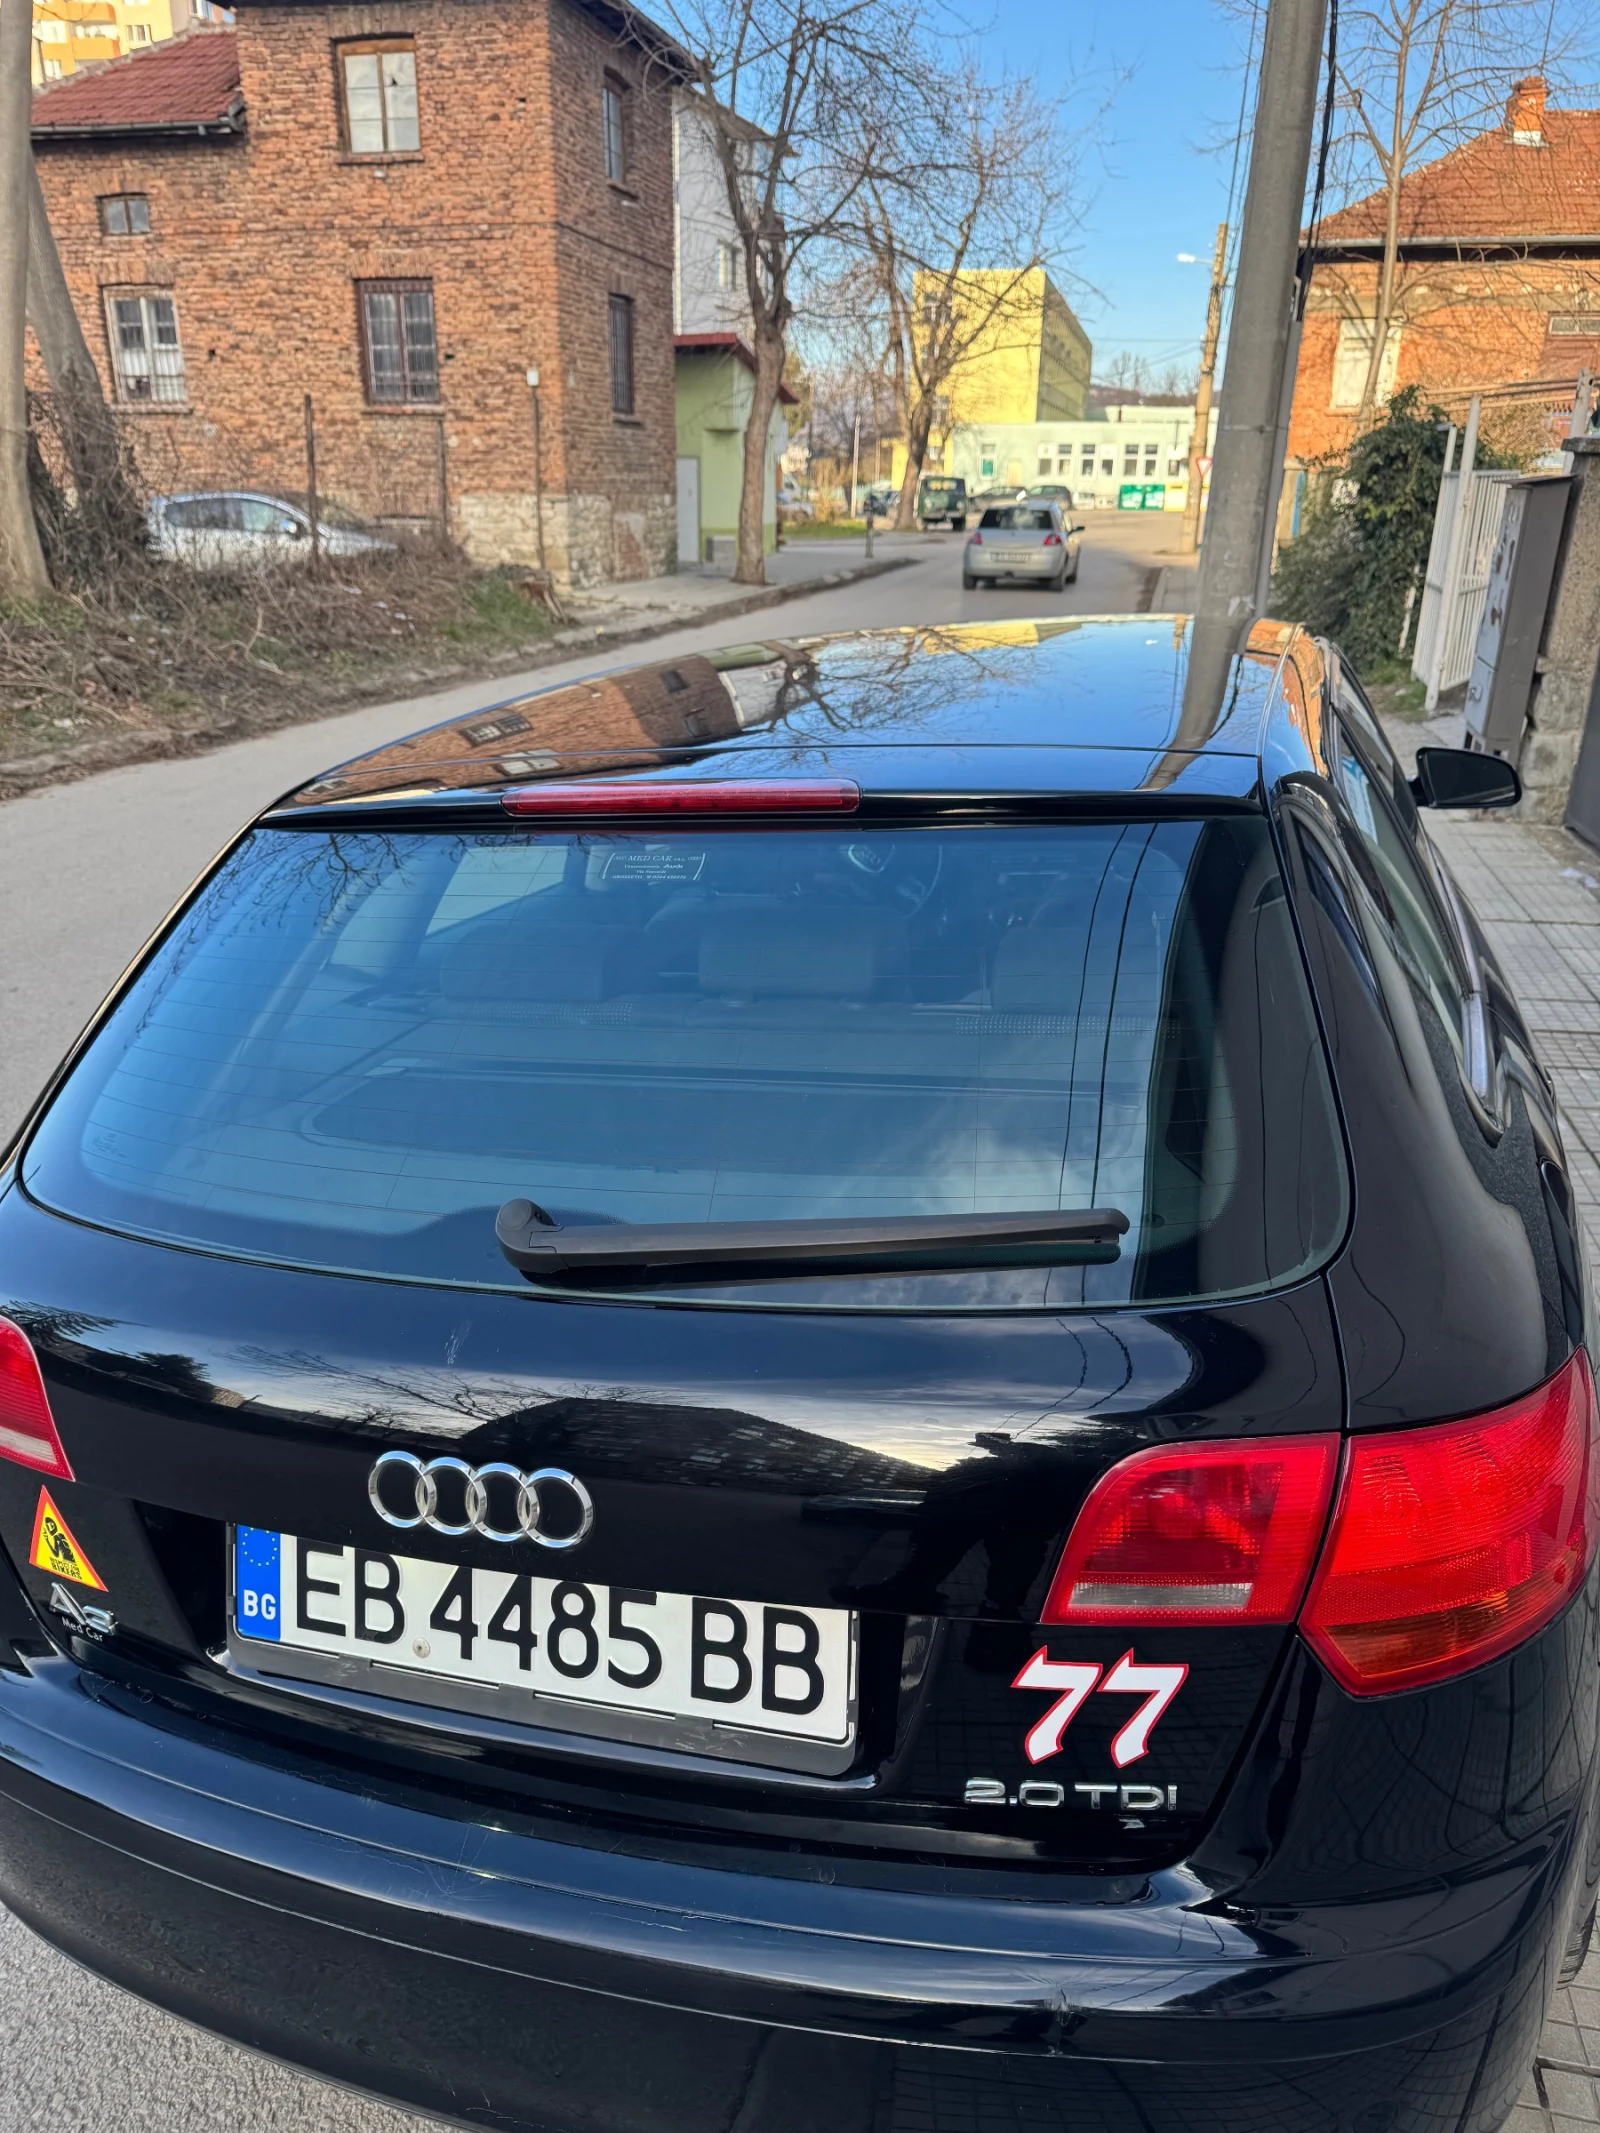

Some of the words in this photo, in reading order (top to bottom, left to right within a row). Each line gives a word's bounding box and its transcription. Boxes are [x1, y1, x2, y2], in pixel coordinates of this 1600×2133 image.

[51, 1563, 82, 1580] BIKERS
[50, 1582, 117, 1635] A3
[243, 1589, 276, 1620] BG
[61, 1616, 83, 1633] Med
[86, 1627, 103, 1642] Car
[296, 1537, 405, 1644] EB
[430, 1567, 662, 1689] 4485
[691, 1596, 824, 1715] BB
[1010, 1645, 1190, 1769] 77
[964, 1776, 1065, 1808] 2.0
[1074, 1782, 1178, 1811] TDI
